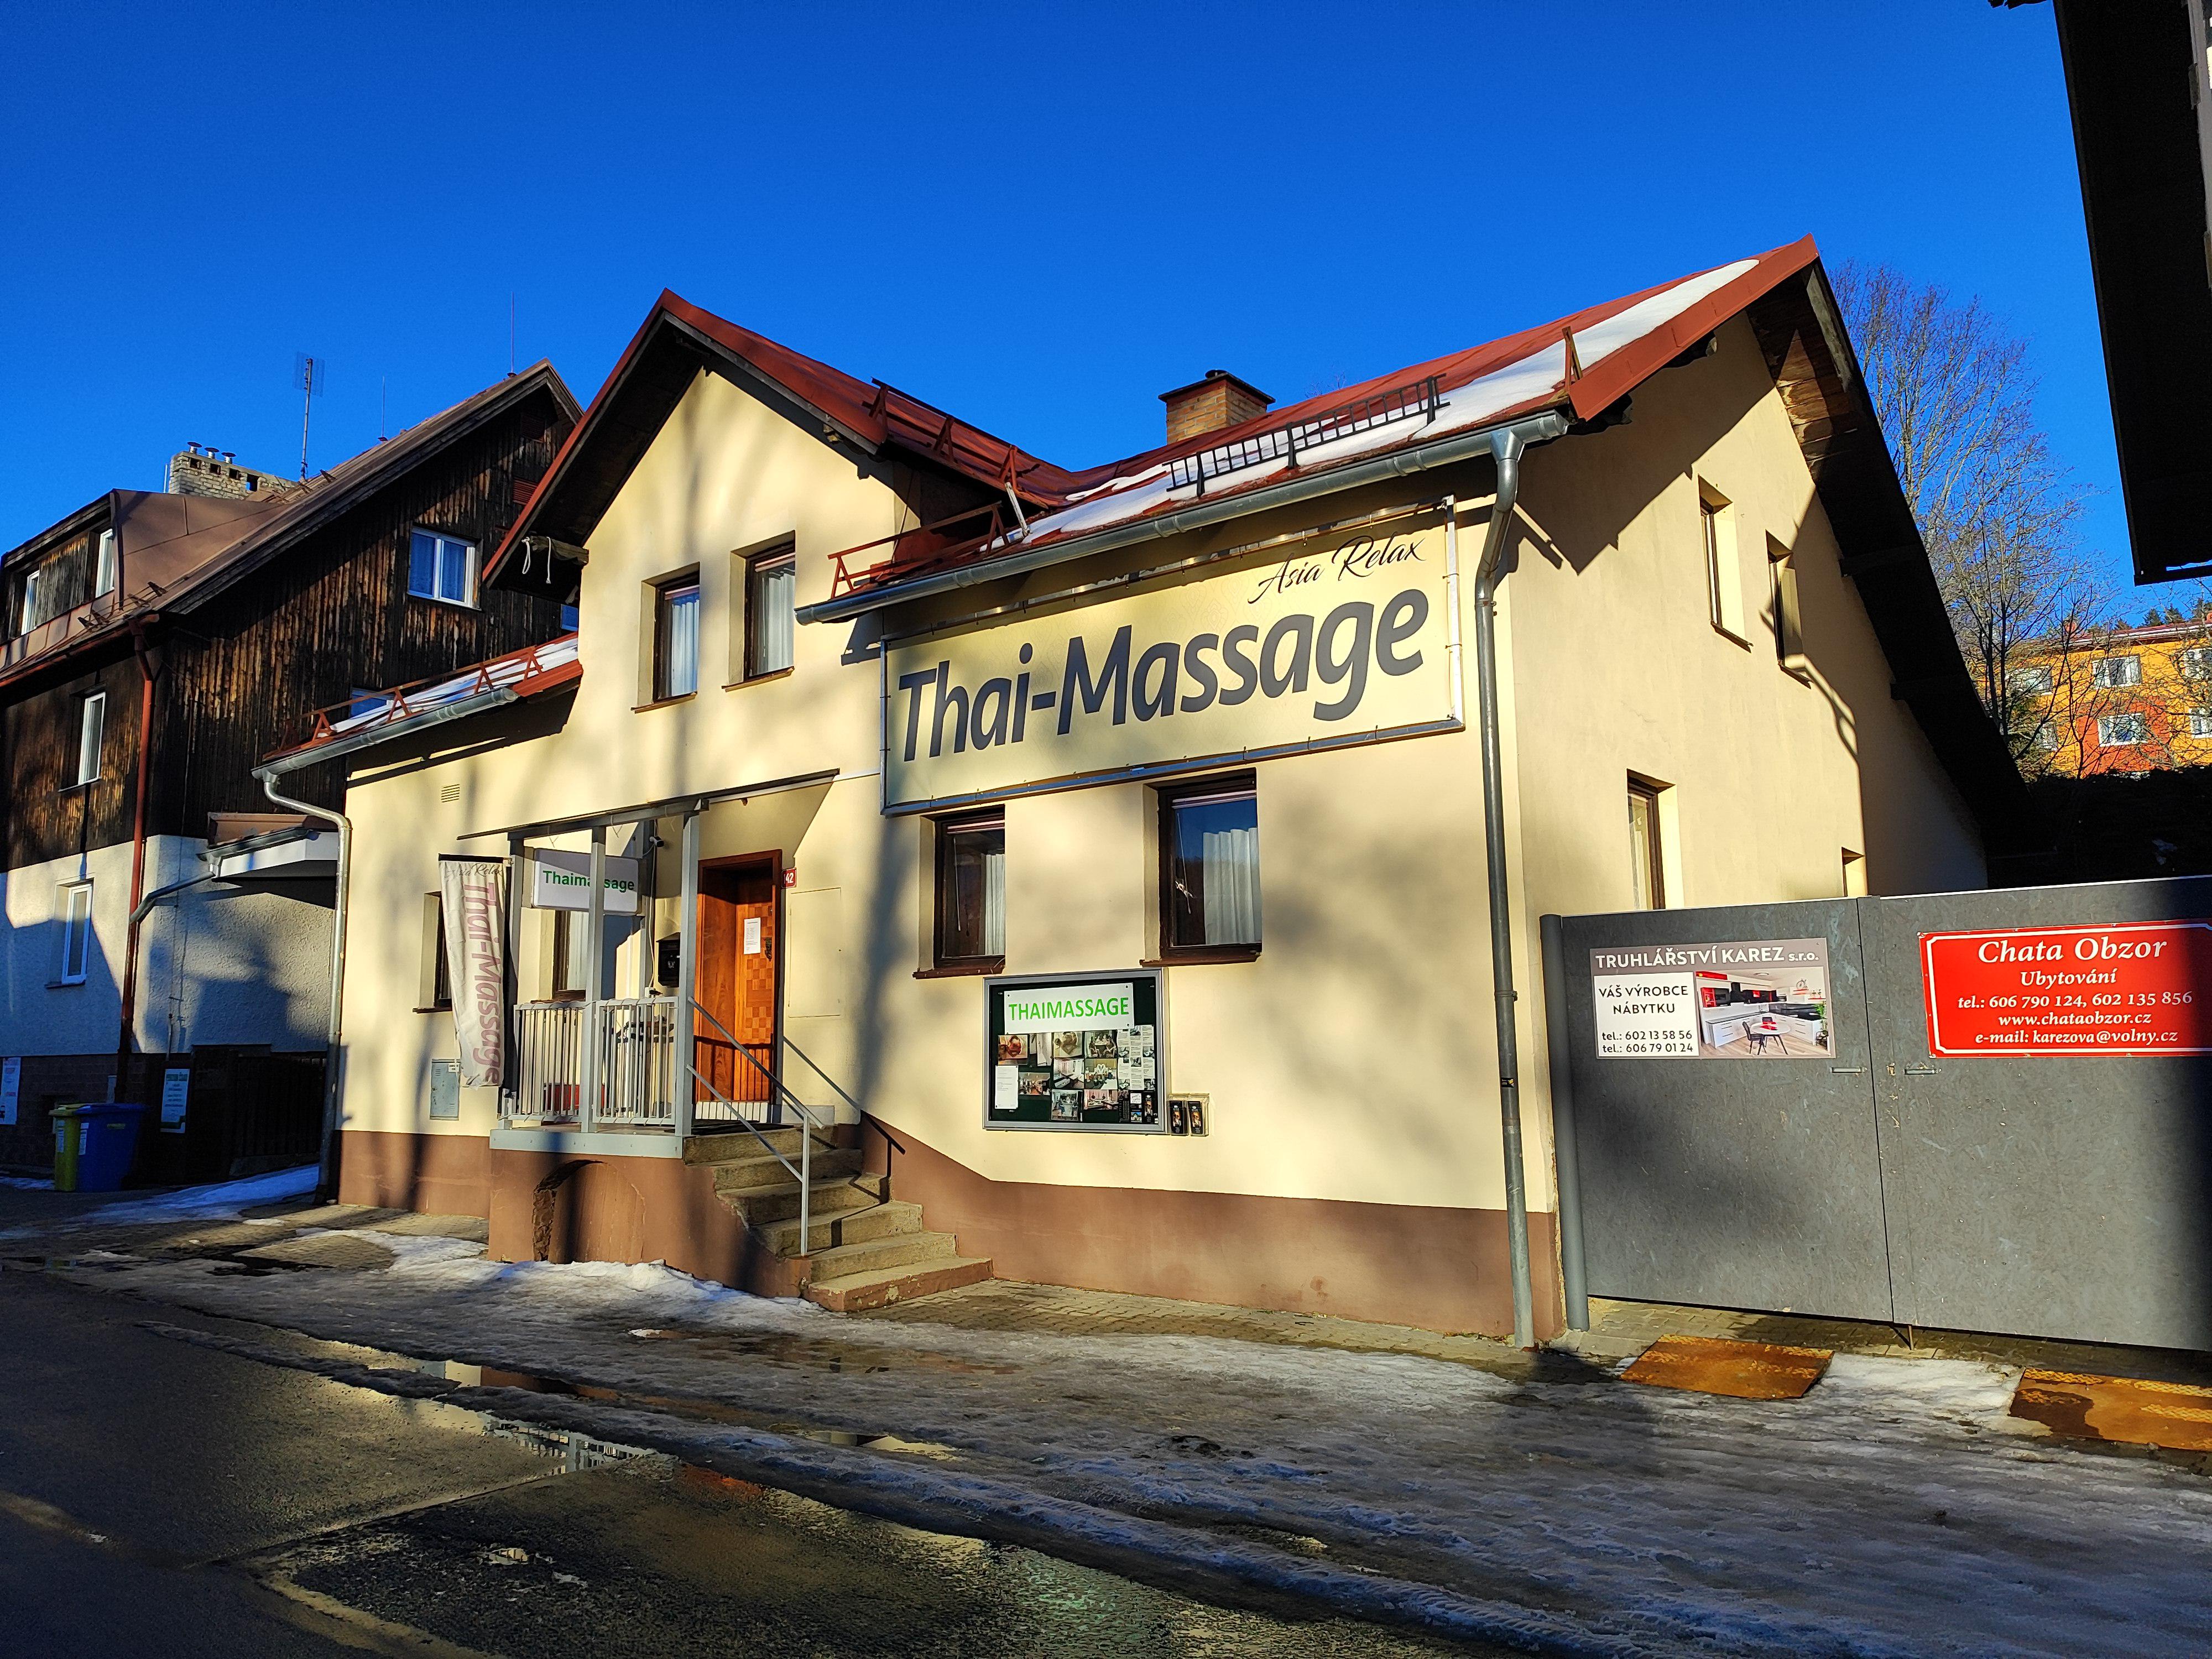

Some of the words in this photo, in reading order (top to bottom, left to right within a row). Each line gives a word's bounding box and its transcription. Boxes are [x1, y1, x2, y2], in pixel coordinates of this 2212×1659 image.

[1248, 552, 1325, 604] Asia
[1332, 534, 1427, 581] Relax
[898, 589, 1428, 761] Thai-Massage
[542, 870, 634, 893] Thaimsage
[1595, 945, 1718, 968] TRUHLÁŘSTVÍ
[1721, 947, 1785, 963] KAREZ
[1788, 951, 1819, 962] s.r.o.
[1978, 940, 2064, 963] Chata
[2074, 936, 2168, 961] Obzor
[464, 882, 502, 1084] Thai-Massage
[2020, 968, 2118, 990] Ubytování
[1598, 984, 1622, 998] VÁŠ
[1625, 984, 1688, 997] VÝROBCE
[1958, 995, 1985, 1009] tel.:
[1989, 995, 2017, 1008] 606
[2021, 995, 2050, 1009] 790
[2055, 995, 2088, 1009] 124,
[2092, 993, 2122, 1006] 602
[2127, 993, 2156, 1006] 135
[2161, 991, 2193, 1005] 856
[1008, 997, 1129, 1021] THAIMASSAGE
[1613, 1001, 1675, 1014] NÁBYTKU
[1998, 1011, 2152, 1026] www.chataobzor.cz
[1601, 1031, 1622, 1040] tel.:
[1625, 1031, 1646, 1040] 602
[1648, 1031, 1659, 1040] 13
[1662, 1030, 1676, 1040] 58
[1679, 1030, 1692, 1040] 56
[1975, 1030, 2029, 1044] e-mail:
[2032, 1029, 2179, 1045] karezova@volny.cz
[1602, 1044, 1622, 1053] tel.:
[1626, 1044, 1647, 1052] 606
[1649, 1043, 1662, 1052] 79
[1665, 1043, 1677, 1052] 01
[1679, 1043, 1693, 1052] 24
